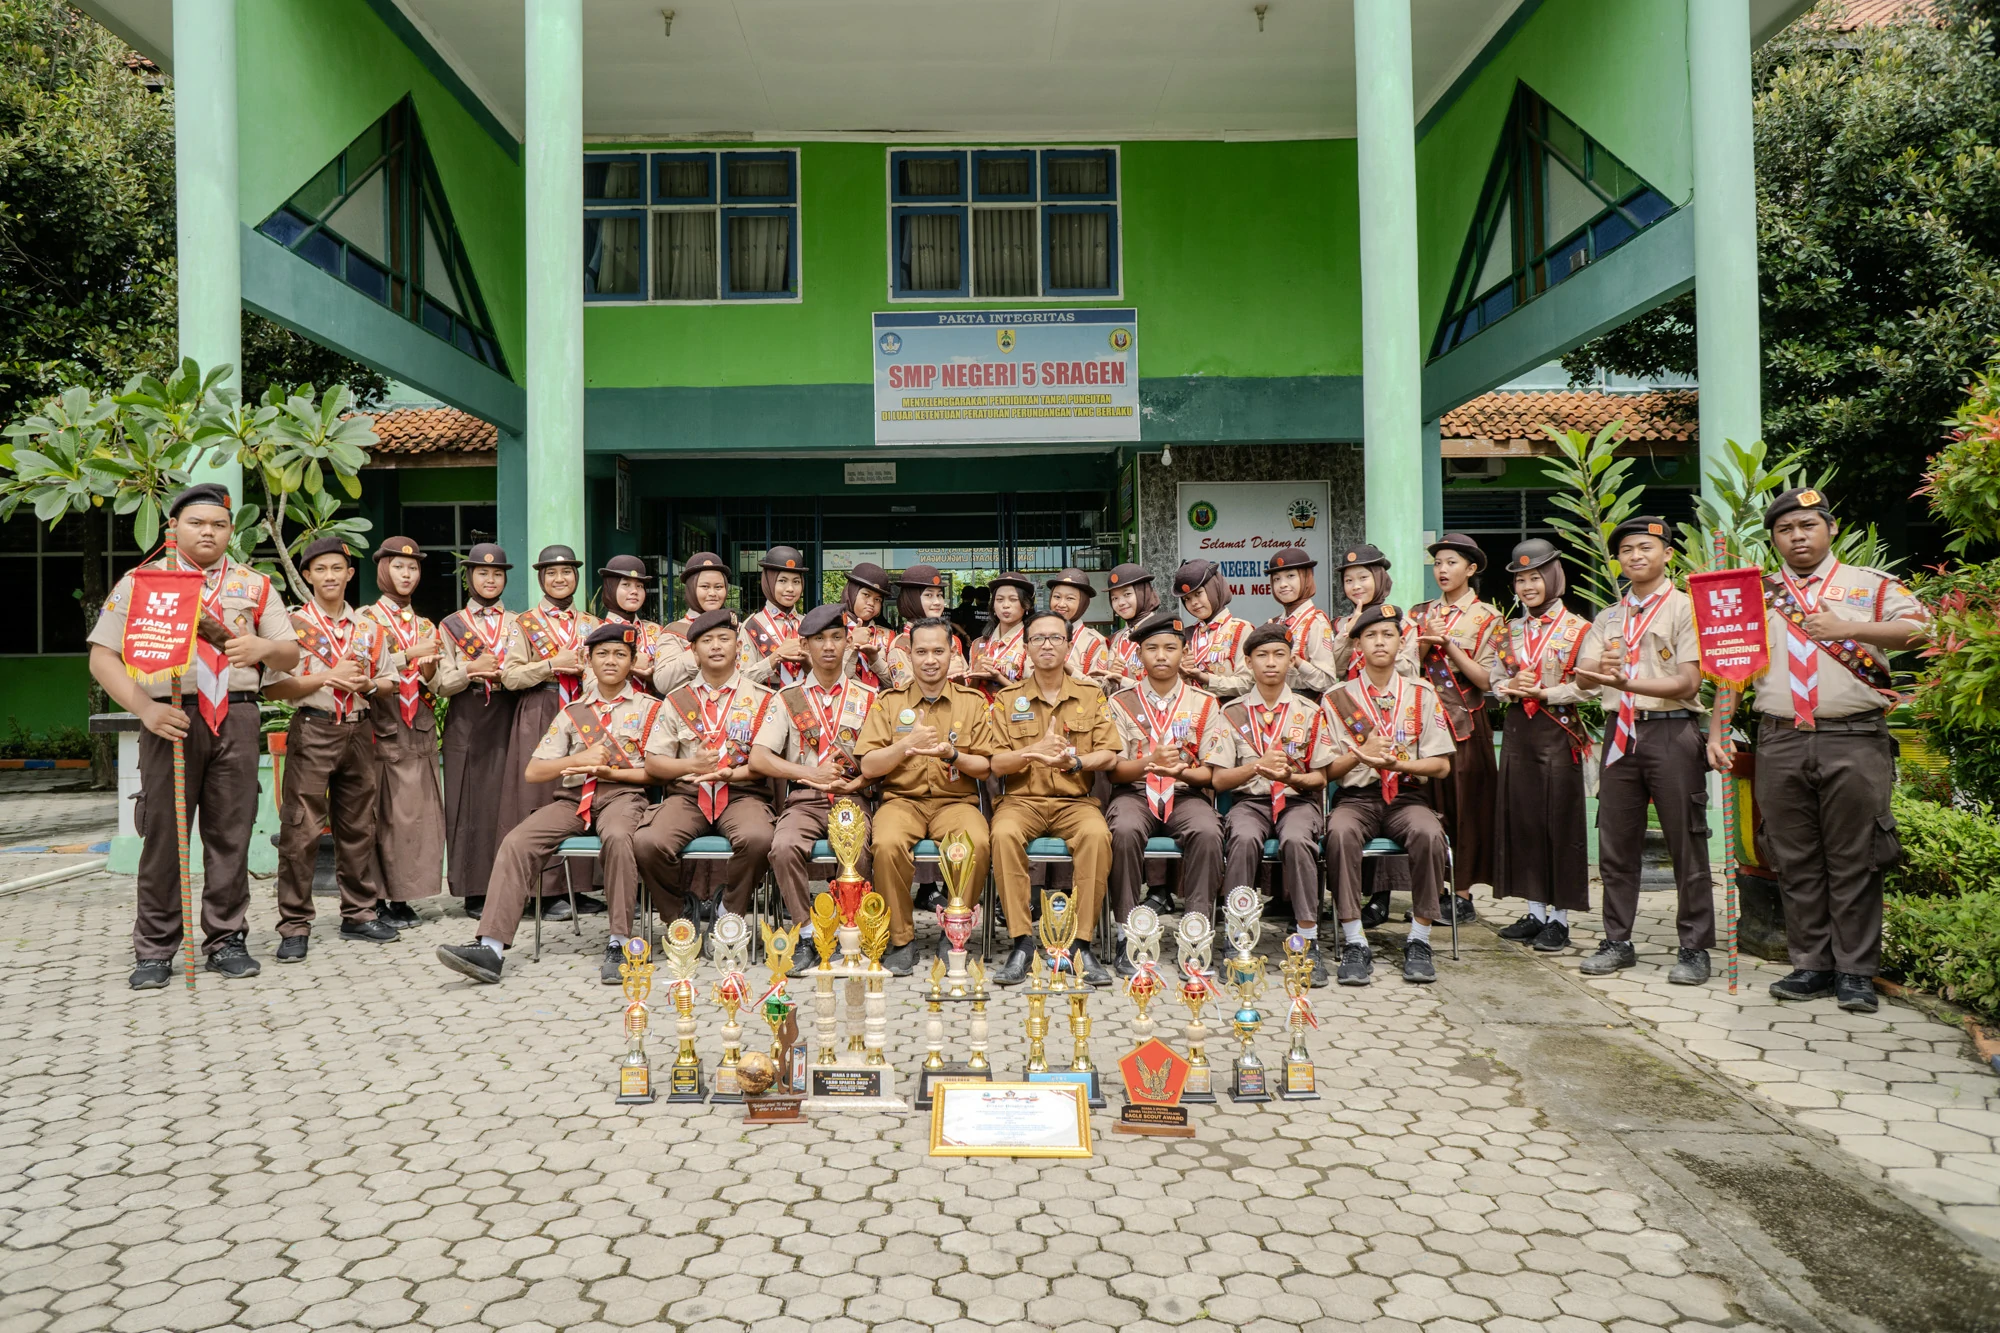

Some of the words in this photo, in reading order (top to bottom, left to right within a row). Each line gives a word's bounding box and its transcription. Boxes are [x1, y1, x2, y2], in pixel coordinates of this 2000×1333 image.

[938, 314, 985, 324] PAKTA
[989, 312, 1075, 323] INTEGRITAS
[888, 364, 937, 388] SMP
[942, 363, 1016, 387] NEGERI
[1022, 362, 1036, 386] 5
[1042, 361, 1125, 385] SRAGEN
[902, 396, 988, 408] MENYELENGGARAKAN
[989, 395, 1039, 406] PENDIDIKAN
[1040, 394, 1066, 405] TANPA
[1068, 394, 1112, 404] PUNGUTAN
[882, 410, 890, 421] DI
[892, 410, 913, 420] LUAR
[914, 409, 961, 420] KETENTUAN
[962, 408, 1010, 419] PERATURAN
[1011, 408, 1072, 418] PERUNDANGAN
[1073, 406, 1094, 417] YANG
[1096, 406, 1132, 416] BERLAKU
[1200, 538, 1246, 550] Selamat
[1251, 536, 1292, 549] Datang
[1294, 537, 1306, 548] di
[1220, 560, 1261, 578] NEGERI
[132, 618, 172, 630] JUARA
[176, 623, 188, 631] III
[142, 626, 172, 634] LOMBA
[1702, 624, 1743, 636] JUARA
[1746, 622, 1758, 631] III
[126, 634, 186, 644] PENGGALANG
[134, 641, 174, 650] RELIGIUS
[1705, 644, 1760, 656] PIONERING
[134, 650, 170, 660] PUTRI
[1716, 656, 1751, 667] PUTRI
